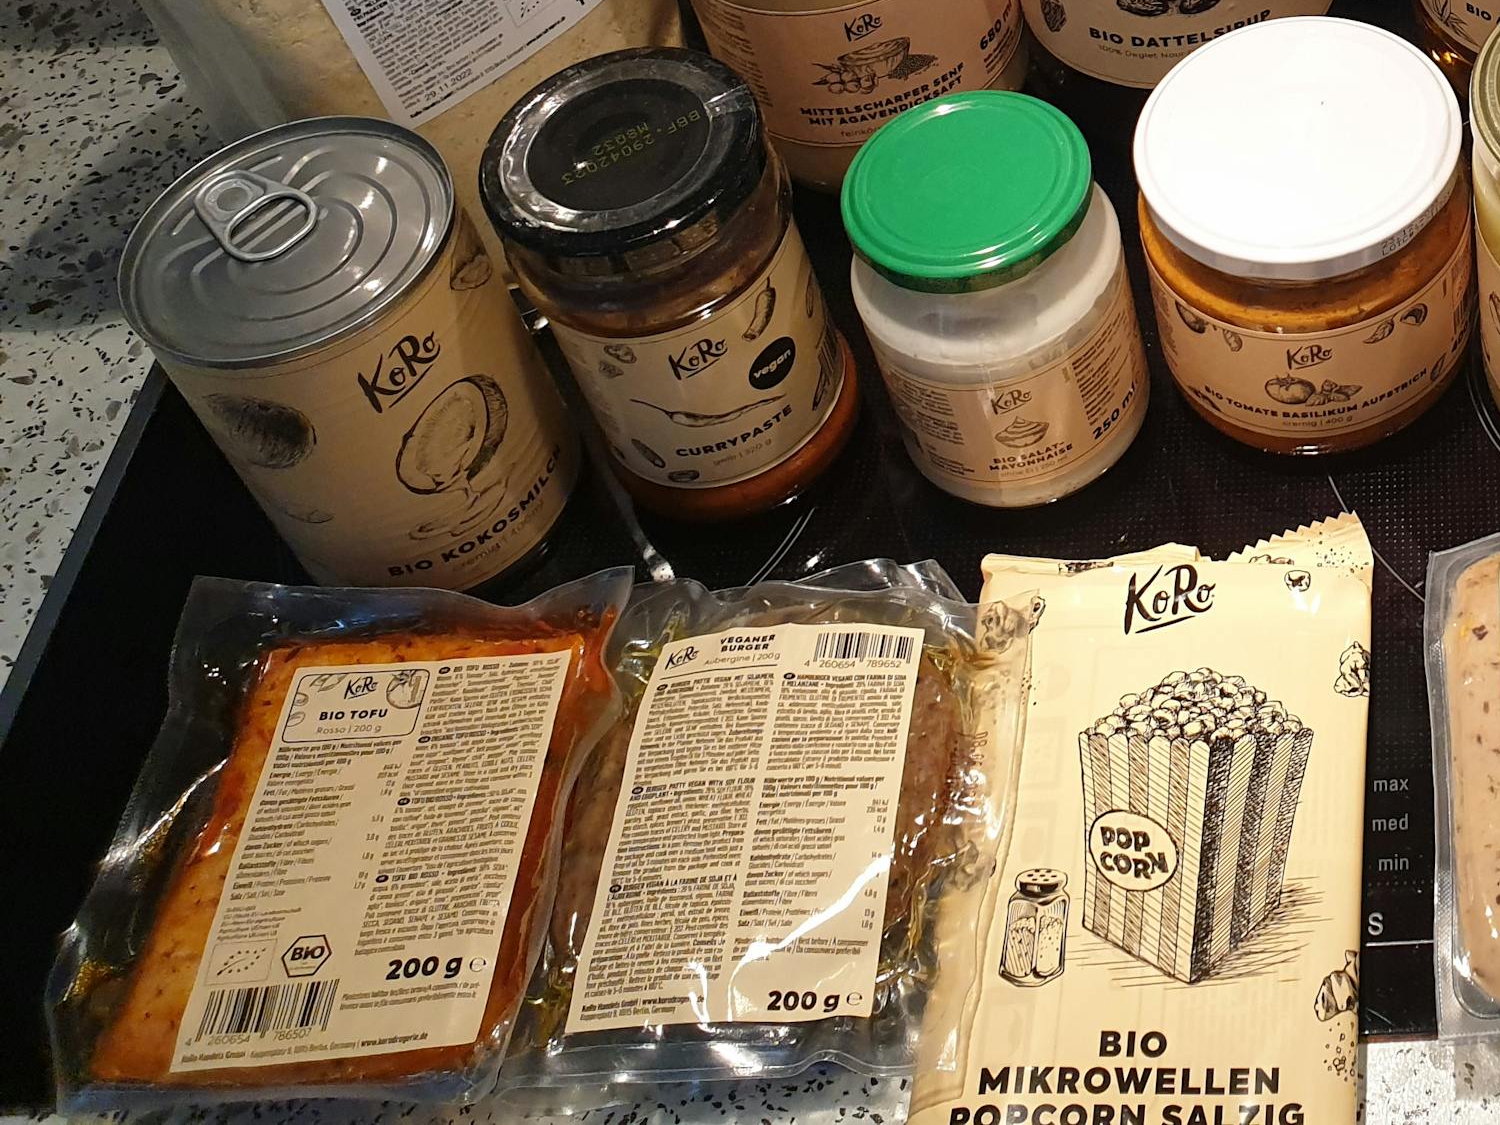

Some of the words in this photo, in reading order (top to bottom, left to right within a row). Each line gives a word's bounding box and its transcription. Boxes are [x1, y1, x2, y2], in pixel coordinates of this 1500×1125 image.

[1465, 2, 1492, 22] BIO
[843, 13, 883, 42] KoRo
[979, 18, 1003, 51] 680
[1089, 27, 1124, 44] BIO
[800, 82, 930, 117] MITTELSCHARFER
[932, 62, 966, 88] SENF
[808, 116, 835, 126] MIT
[838, 75, 963, 125] AGAVENDICKSAFT
[668, 338, 728, 380] KoRo
[753, 348, 791, 379] vegan
[1286, 344, 1333, 370] KoRo
[357, 331, 442, 413] KoRo
[990, 389, 1032, 415] KoRo
[1204, 385, 1223, 400] BIO
[1225, 397, 1278, 417] TOMATE
[1282, 404, 1357, 418] BASILIKUM
[1361, 368, 1428, 409] AUFSTRICH
[676, 404, 793, 456] CURRYPASTE
[1092, 407, 1120, 440] 250
[989, 443, 1073, 471] MAYONNAISE
[993, 456, 1017, 464] BIO
[388, 560, 433, 577] BIO
[441, 444, 560, 563] KOKOSMILCH
[1123, 564, 1215, 635] KoRo
[720, 634, 776, 645] VEGANER
[721, 642, 770, 653] BURGER
[664, 646, 699, 671] KoRo
[704, 654, 750, 666] Aubergine
[819, 660, 856, 668] 260654
[866, 660, 902, 668] 789652
[344, 676, 379, 700] KoRo
[319, 710, 345, 721] BIO
[349, 708, 388, 720] TOFU
[316, 725, 346, 734] Rosso
[352, 724, 374, 733] 200
[375, 726, 382, 735] g
[1373, 778, 1409, 792] max
[1372, 813, 1409, 832] med
[1099, 825, 1150, 851] POP
[1098, 848, 1169, 881] CORN
[1378, 853, 1409, 871] min
[1367, 912, 1384, 936] S
[291, 945, 325, 961] BIO
[386, 956, 439, 981] 200
[443, 956, 463, 980] g
[767, 991, 817, 1011] 200
[823, 992, 840, 1013] g
[185, 1038, 192, 1047] 4
[207, 1035, 251, 1046] 260654
[273, 1027, 313, 1040] 786507
[1099, 1030, 1168, 1059] BIO
[977, 1067, 1281, 1096] MIKROWELLEN
[949, 1105, 1156, 1125] POPCORN
[1163, 1103, 1305, 1125] SALZIG
